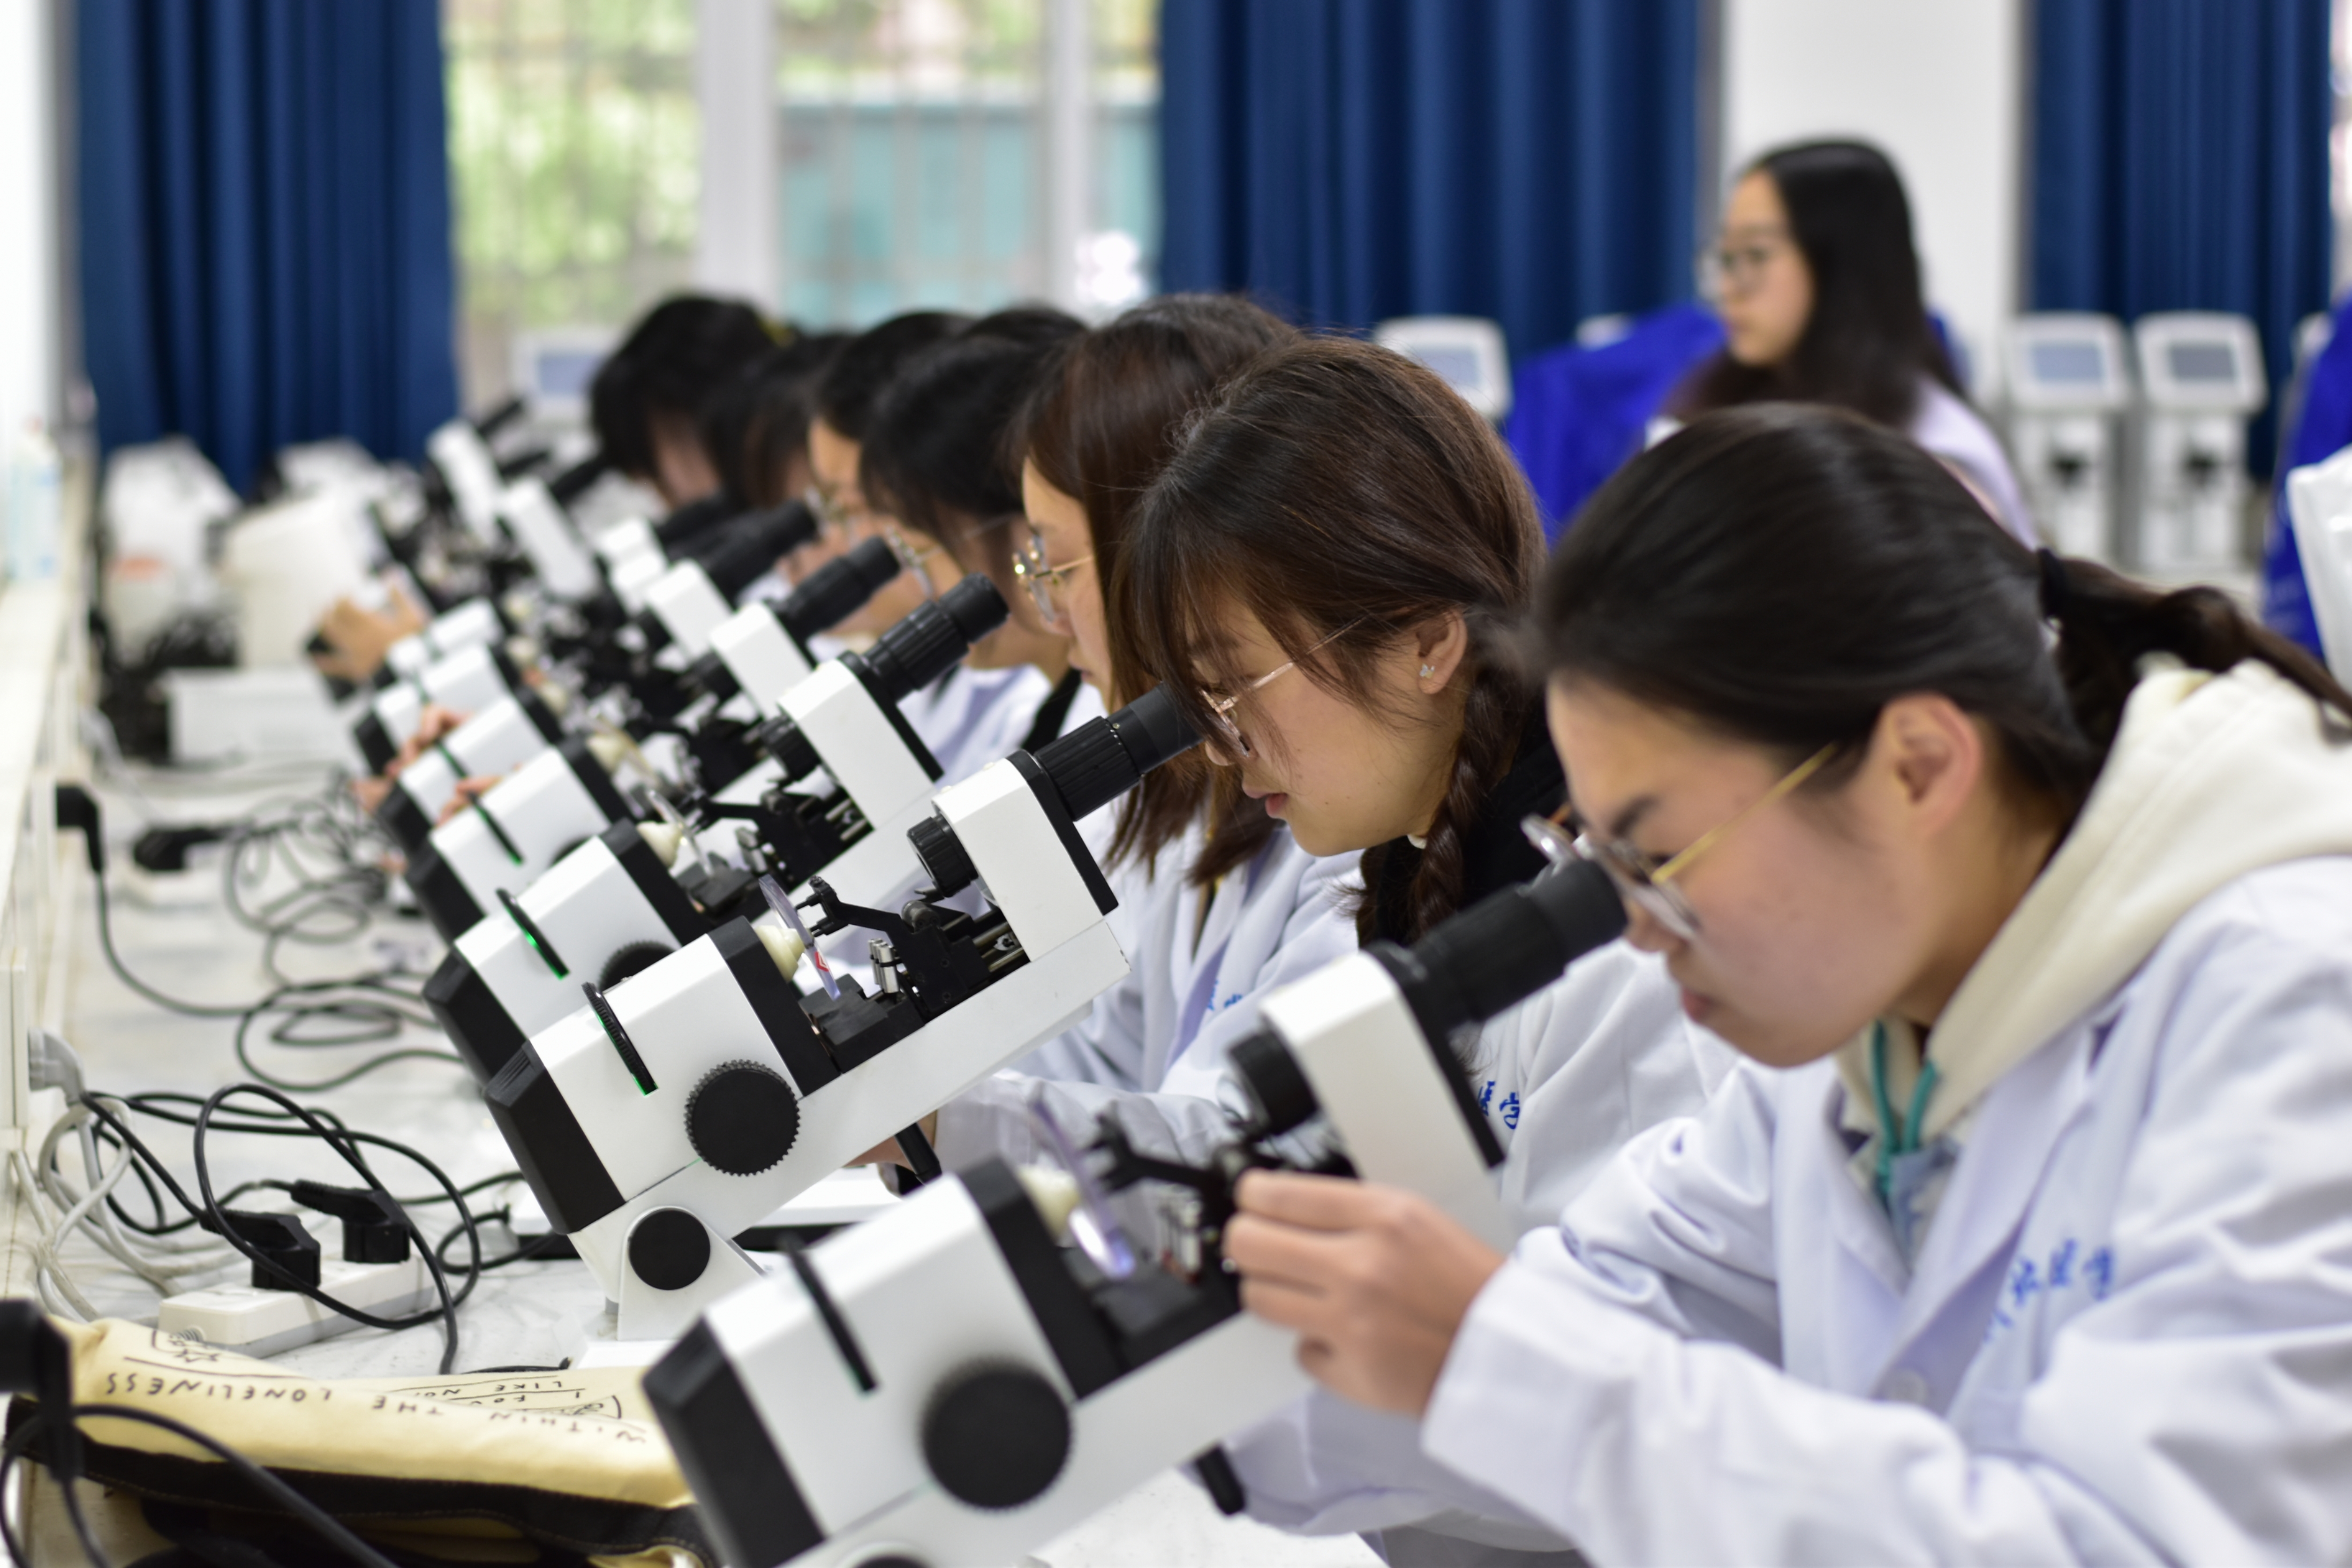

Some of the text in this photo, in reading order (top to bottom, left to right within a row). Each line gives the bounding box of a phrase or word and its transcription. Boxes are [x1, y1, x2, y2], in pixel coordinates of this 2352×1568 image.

[106, 1372, 331, 1402] LONELINESS
[495, 1381, 562, 1392] LIKE
[372, 1395, 444, 1416] THE
